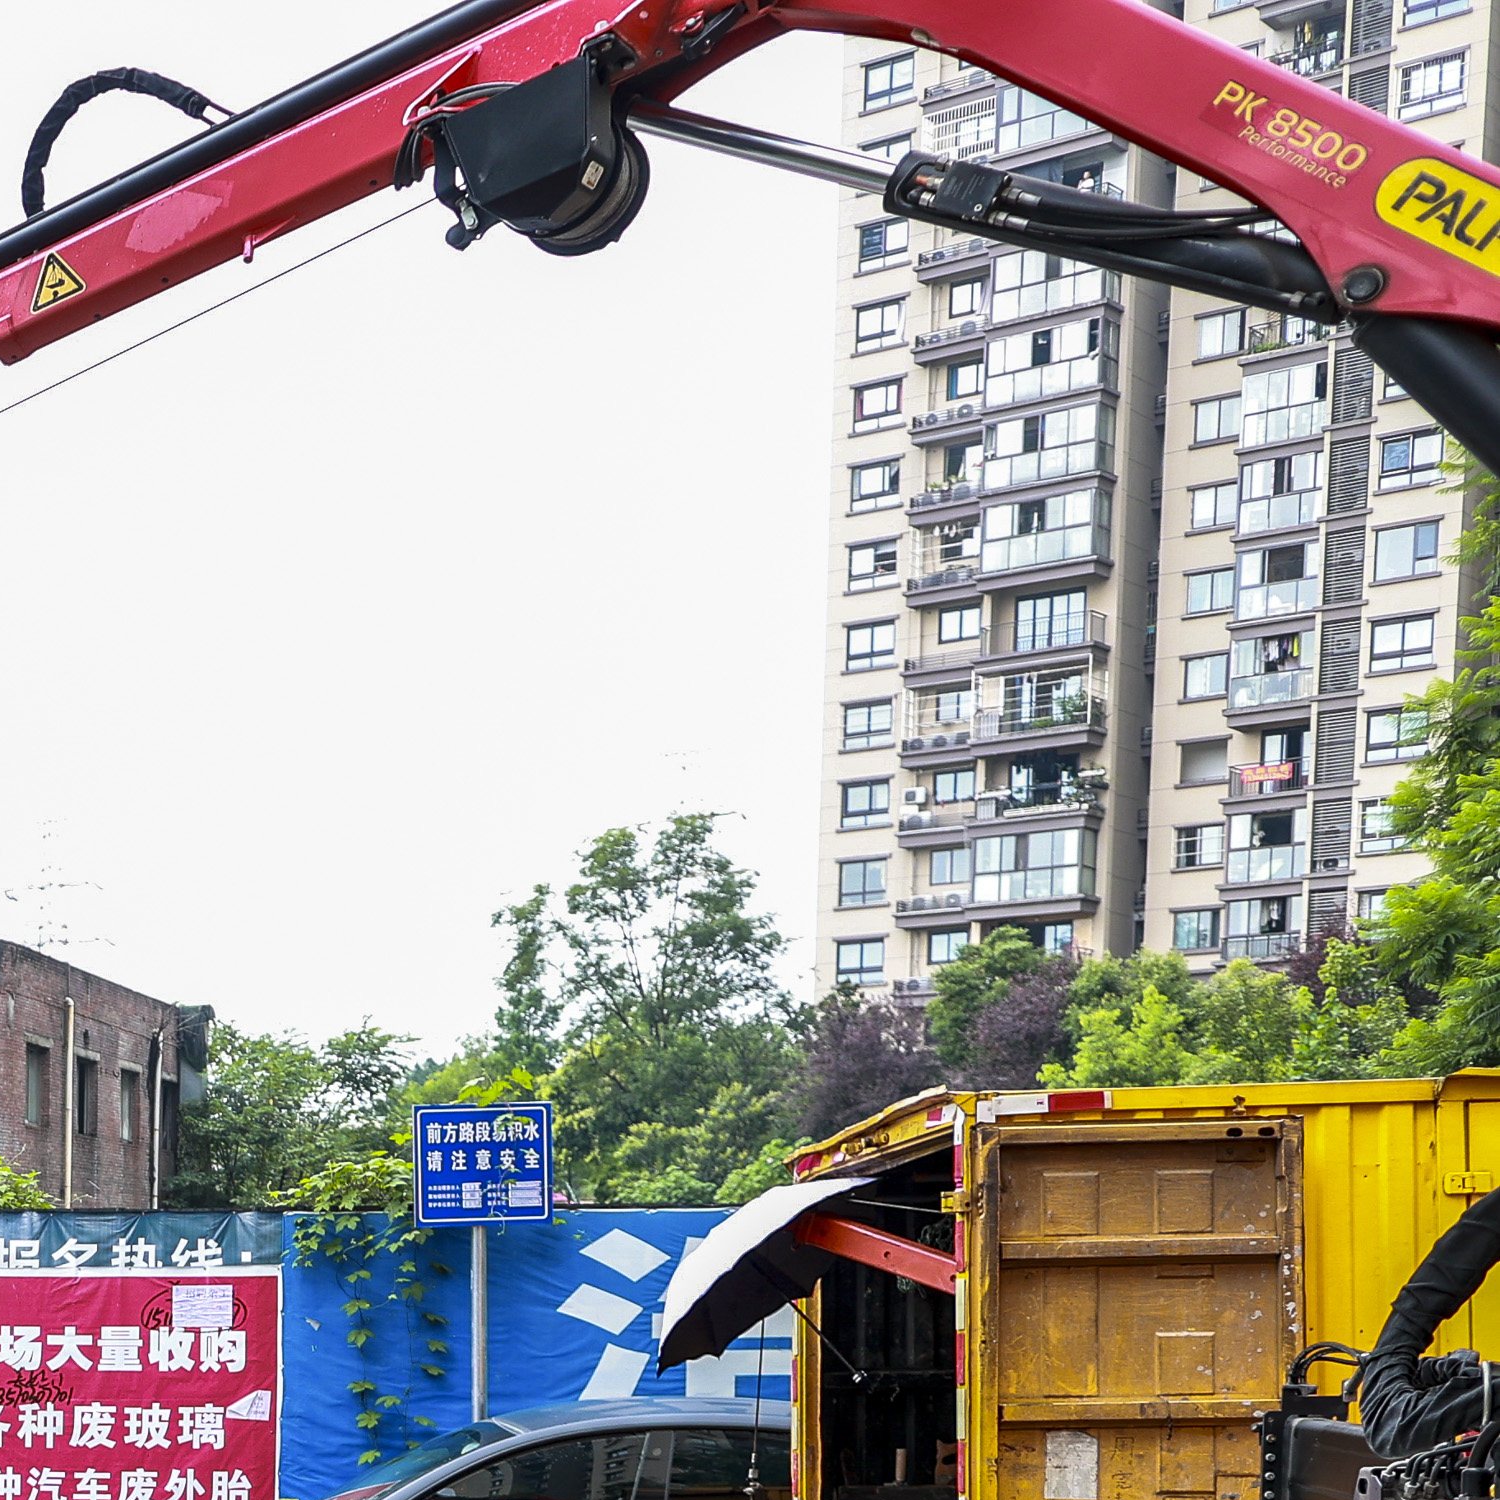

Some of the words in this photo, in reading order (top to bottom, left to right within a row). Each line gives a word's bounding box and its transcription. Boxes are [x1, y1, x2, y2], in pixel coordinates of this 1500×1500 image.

[1213, 80, 1268, 122] PK
[1267, 108, 1368, 170] 8500
[1238, 125, 1348, 189] Performance
[426, 1121, 540, 1144] 前方路段易积水
[426, 1148, 540, 1171] 请注意安全
